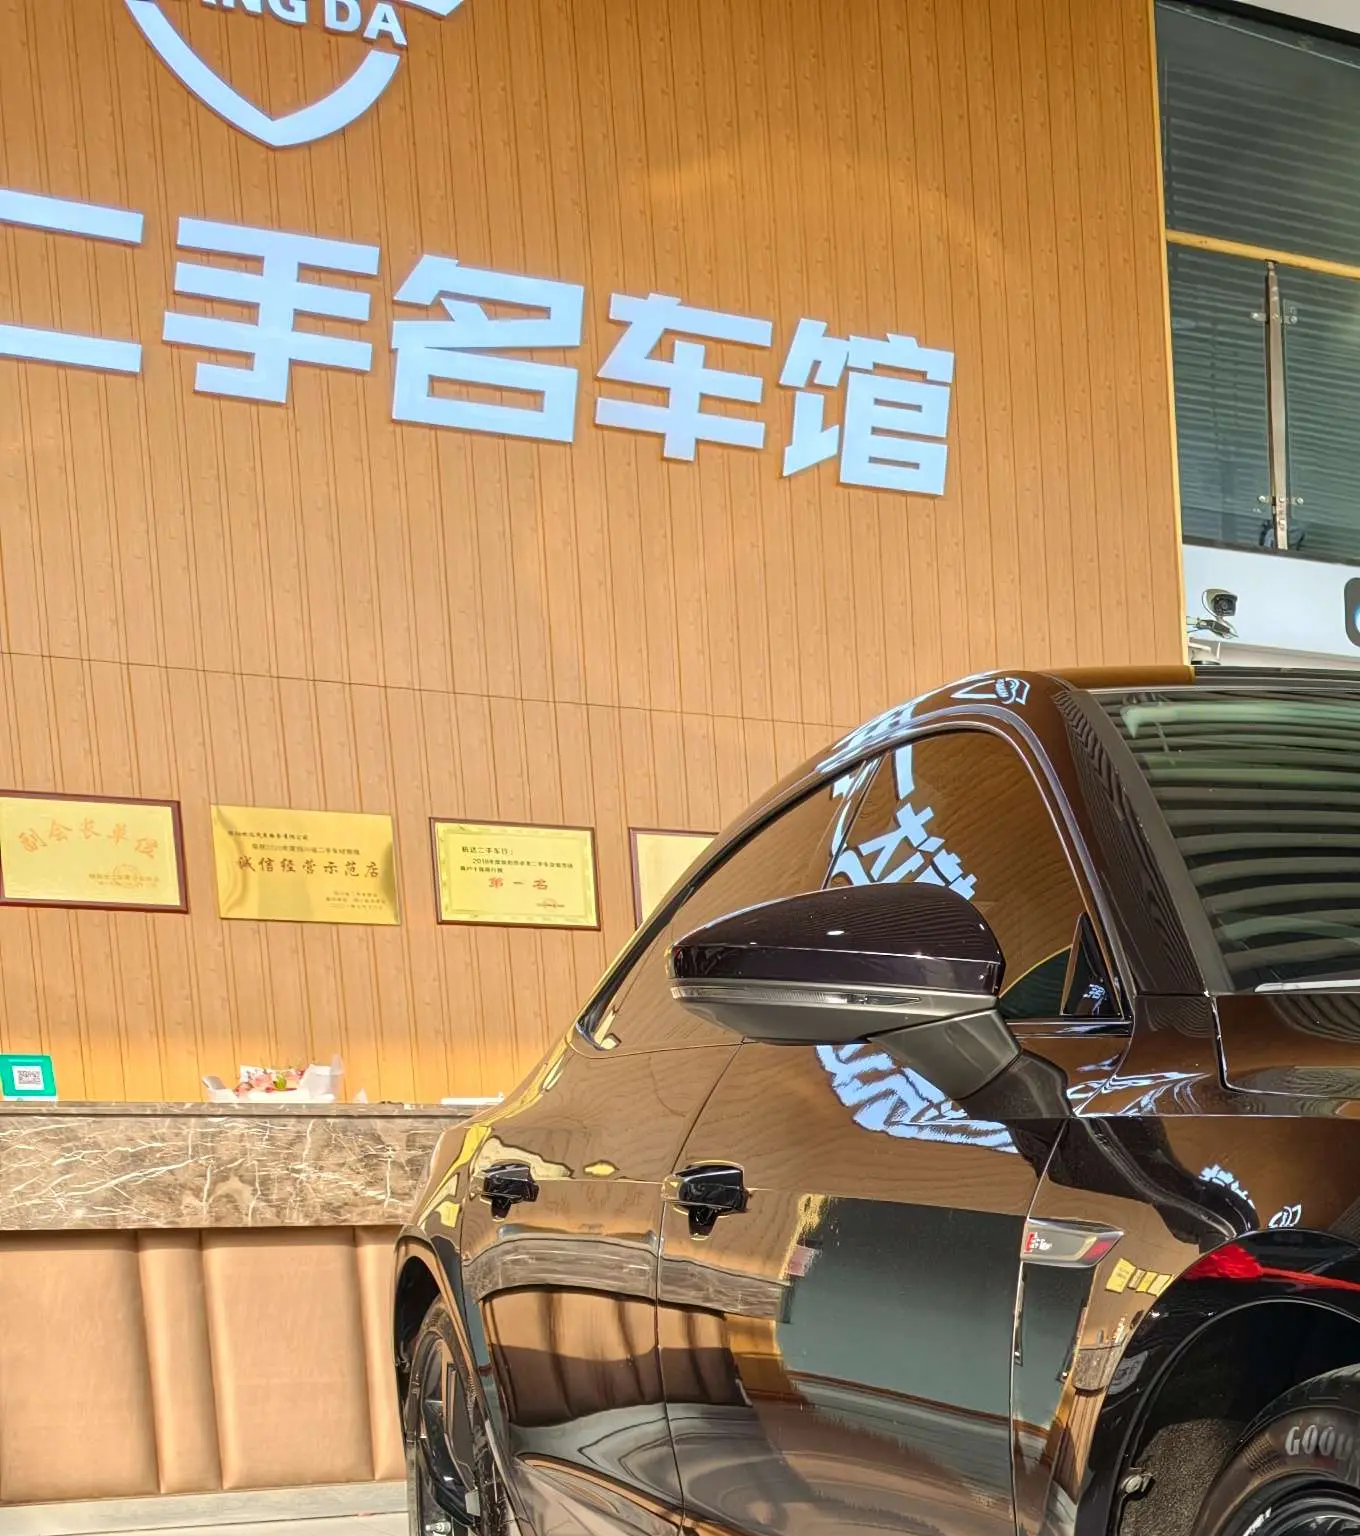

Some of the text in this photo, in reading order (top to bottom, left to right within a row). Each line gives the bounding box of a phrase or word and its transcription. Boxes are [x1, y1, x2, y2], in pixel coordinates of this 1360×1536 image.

[0, 190, 955, 496] 二手名车馆
